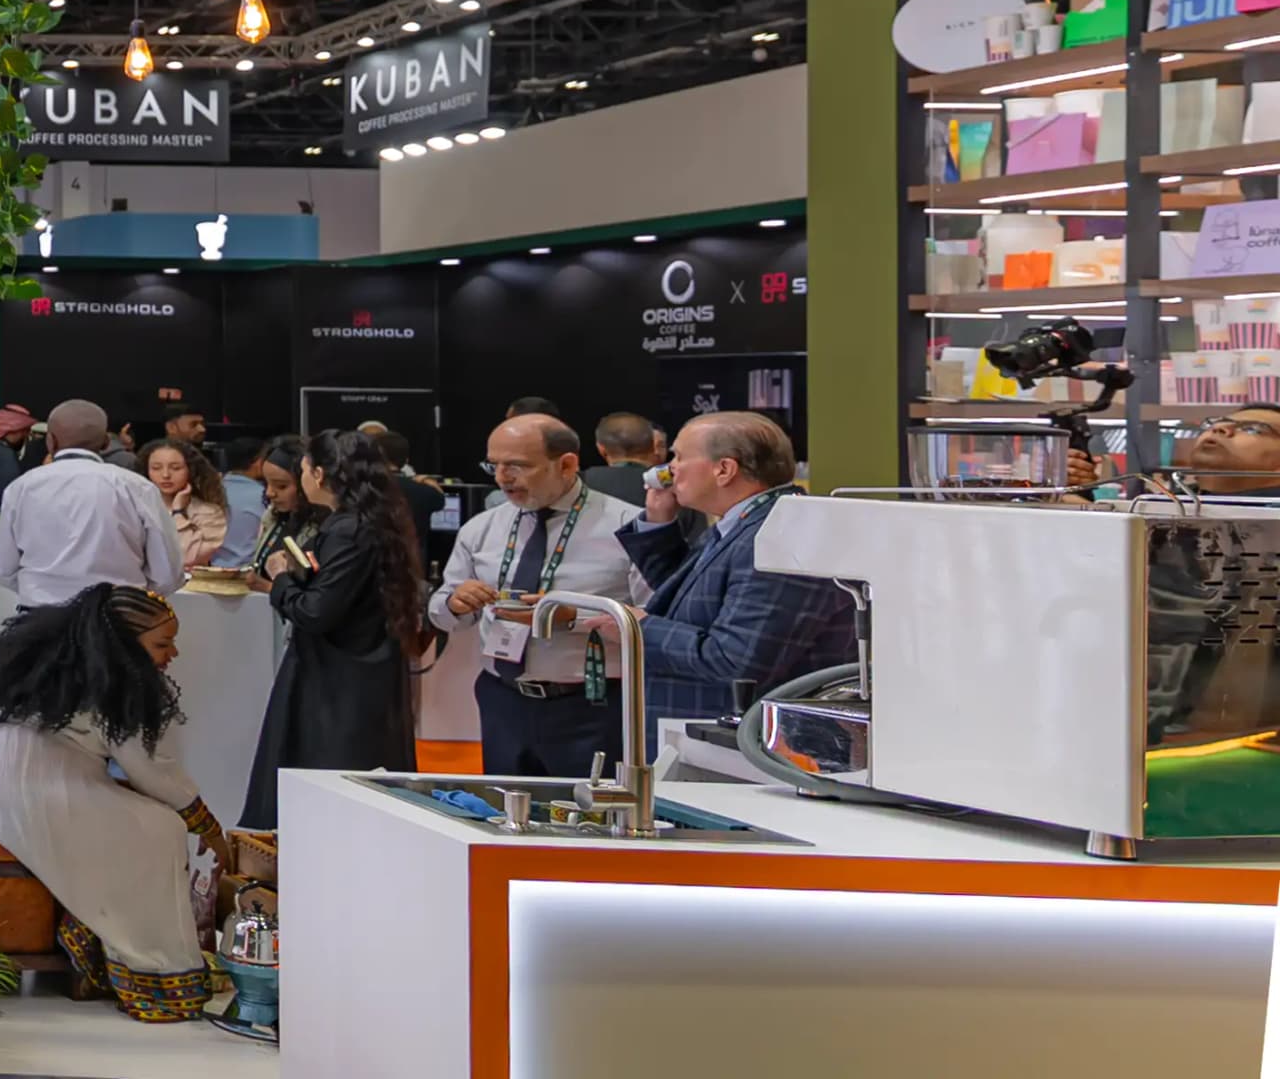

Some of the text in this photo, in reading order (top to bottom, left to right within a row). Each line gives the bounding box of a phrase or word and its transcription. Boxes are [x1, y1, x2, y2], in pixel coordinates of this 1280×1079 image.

[350, 37, 484, 114] KUBAN
[68, 133, 149, 146] PROCESSING
[54, 301, 175, 316] STRONGHOLD
[642, 305, 715, 325] ORIGINS
[312, 327, 415, 339] STRONGHOLD
[659, 323, 696, 335] COFFEE
